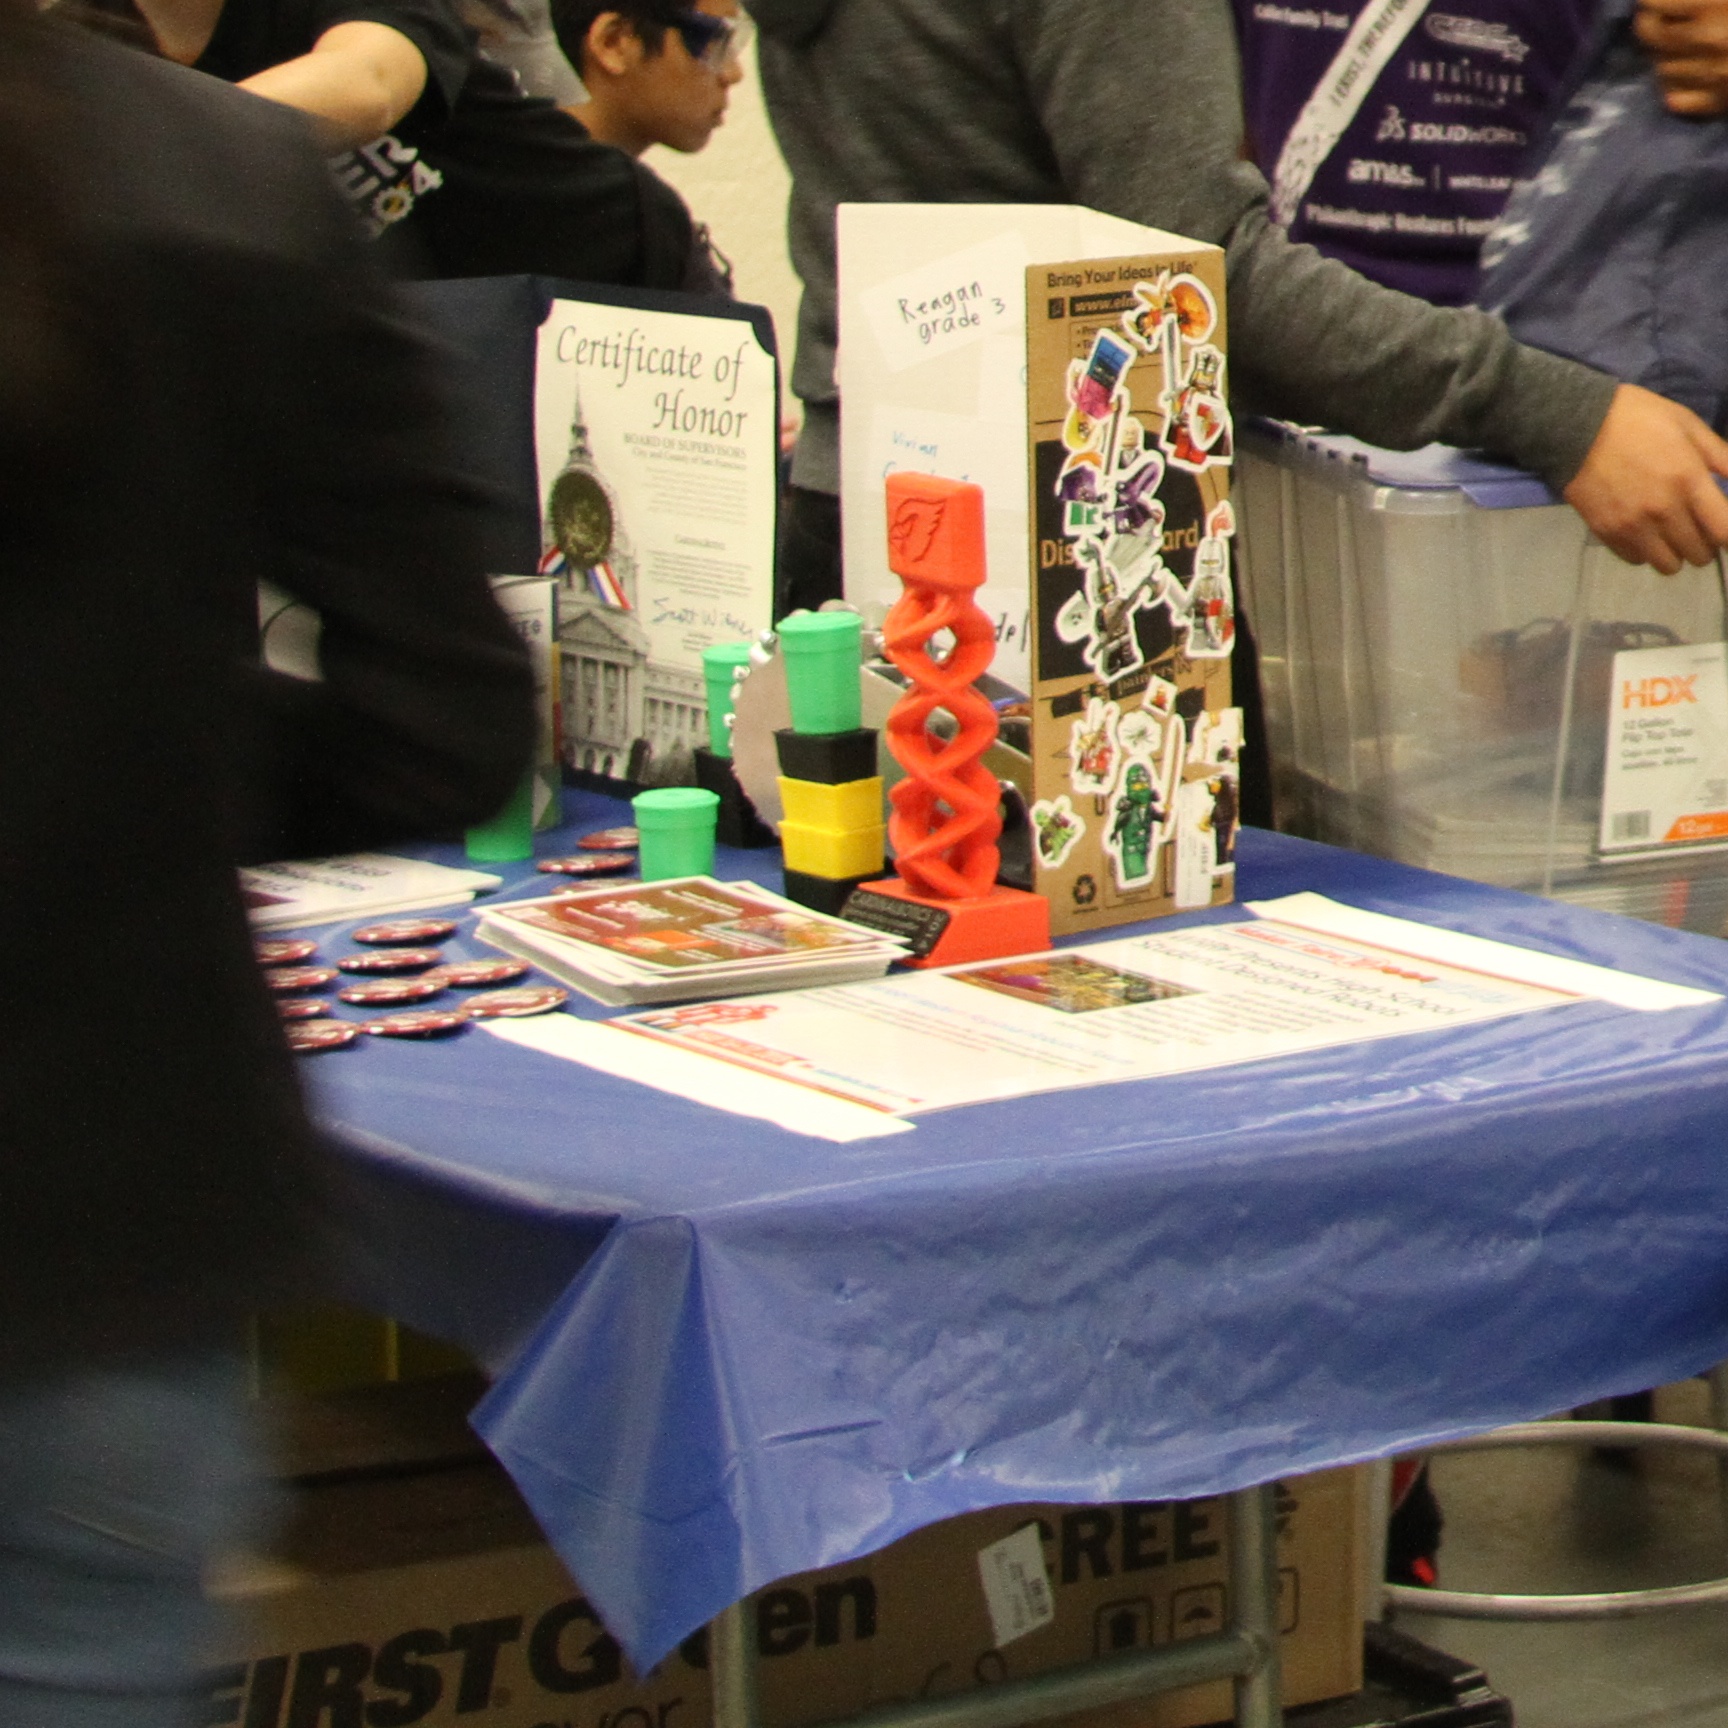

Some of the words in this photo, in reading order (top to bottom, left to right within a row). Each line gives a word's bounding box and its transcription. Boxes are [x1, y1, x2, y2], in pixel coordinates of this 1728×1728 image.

[1047, 272, 1082, 288] Bring
[1085, 270, 1116, 284] Your
[1118, 265, 1154, 280] Ideas
[1170, 260, 1193, 275] Life
[898, 281, 983, 324] Reagan
[919, 302, 981, 345] grade
[557, 324, 703, 388] Certificate
[715, 341, 749, 402] of
[654, 392, 748, 440] Honor
[1161, 520, 1199, 552] ard
[1622, 673, 1700, 710] HDX
[192, 1614, 542, 1728] FIRST
[528, 1575, 878, 1695] Gen
